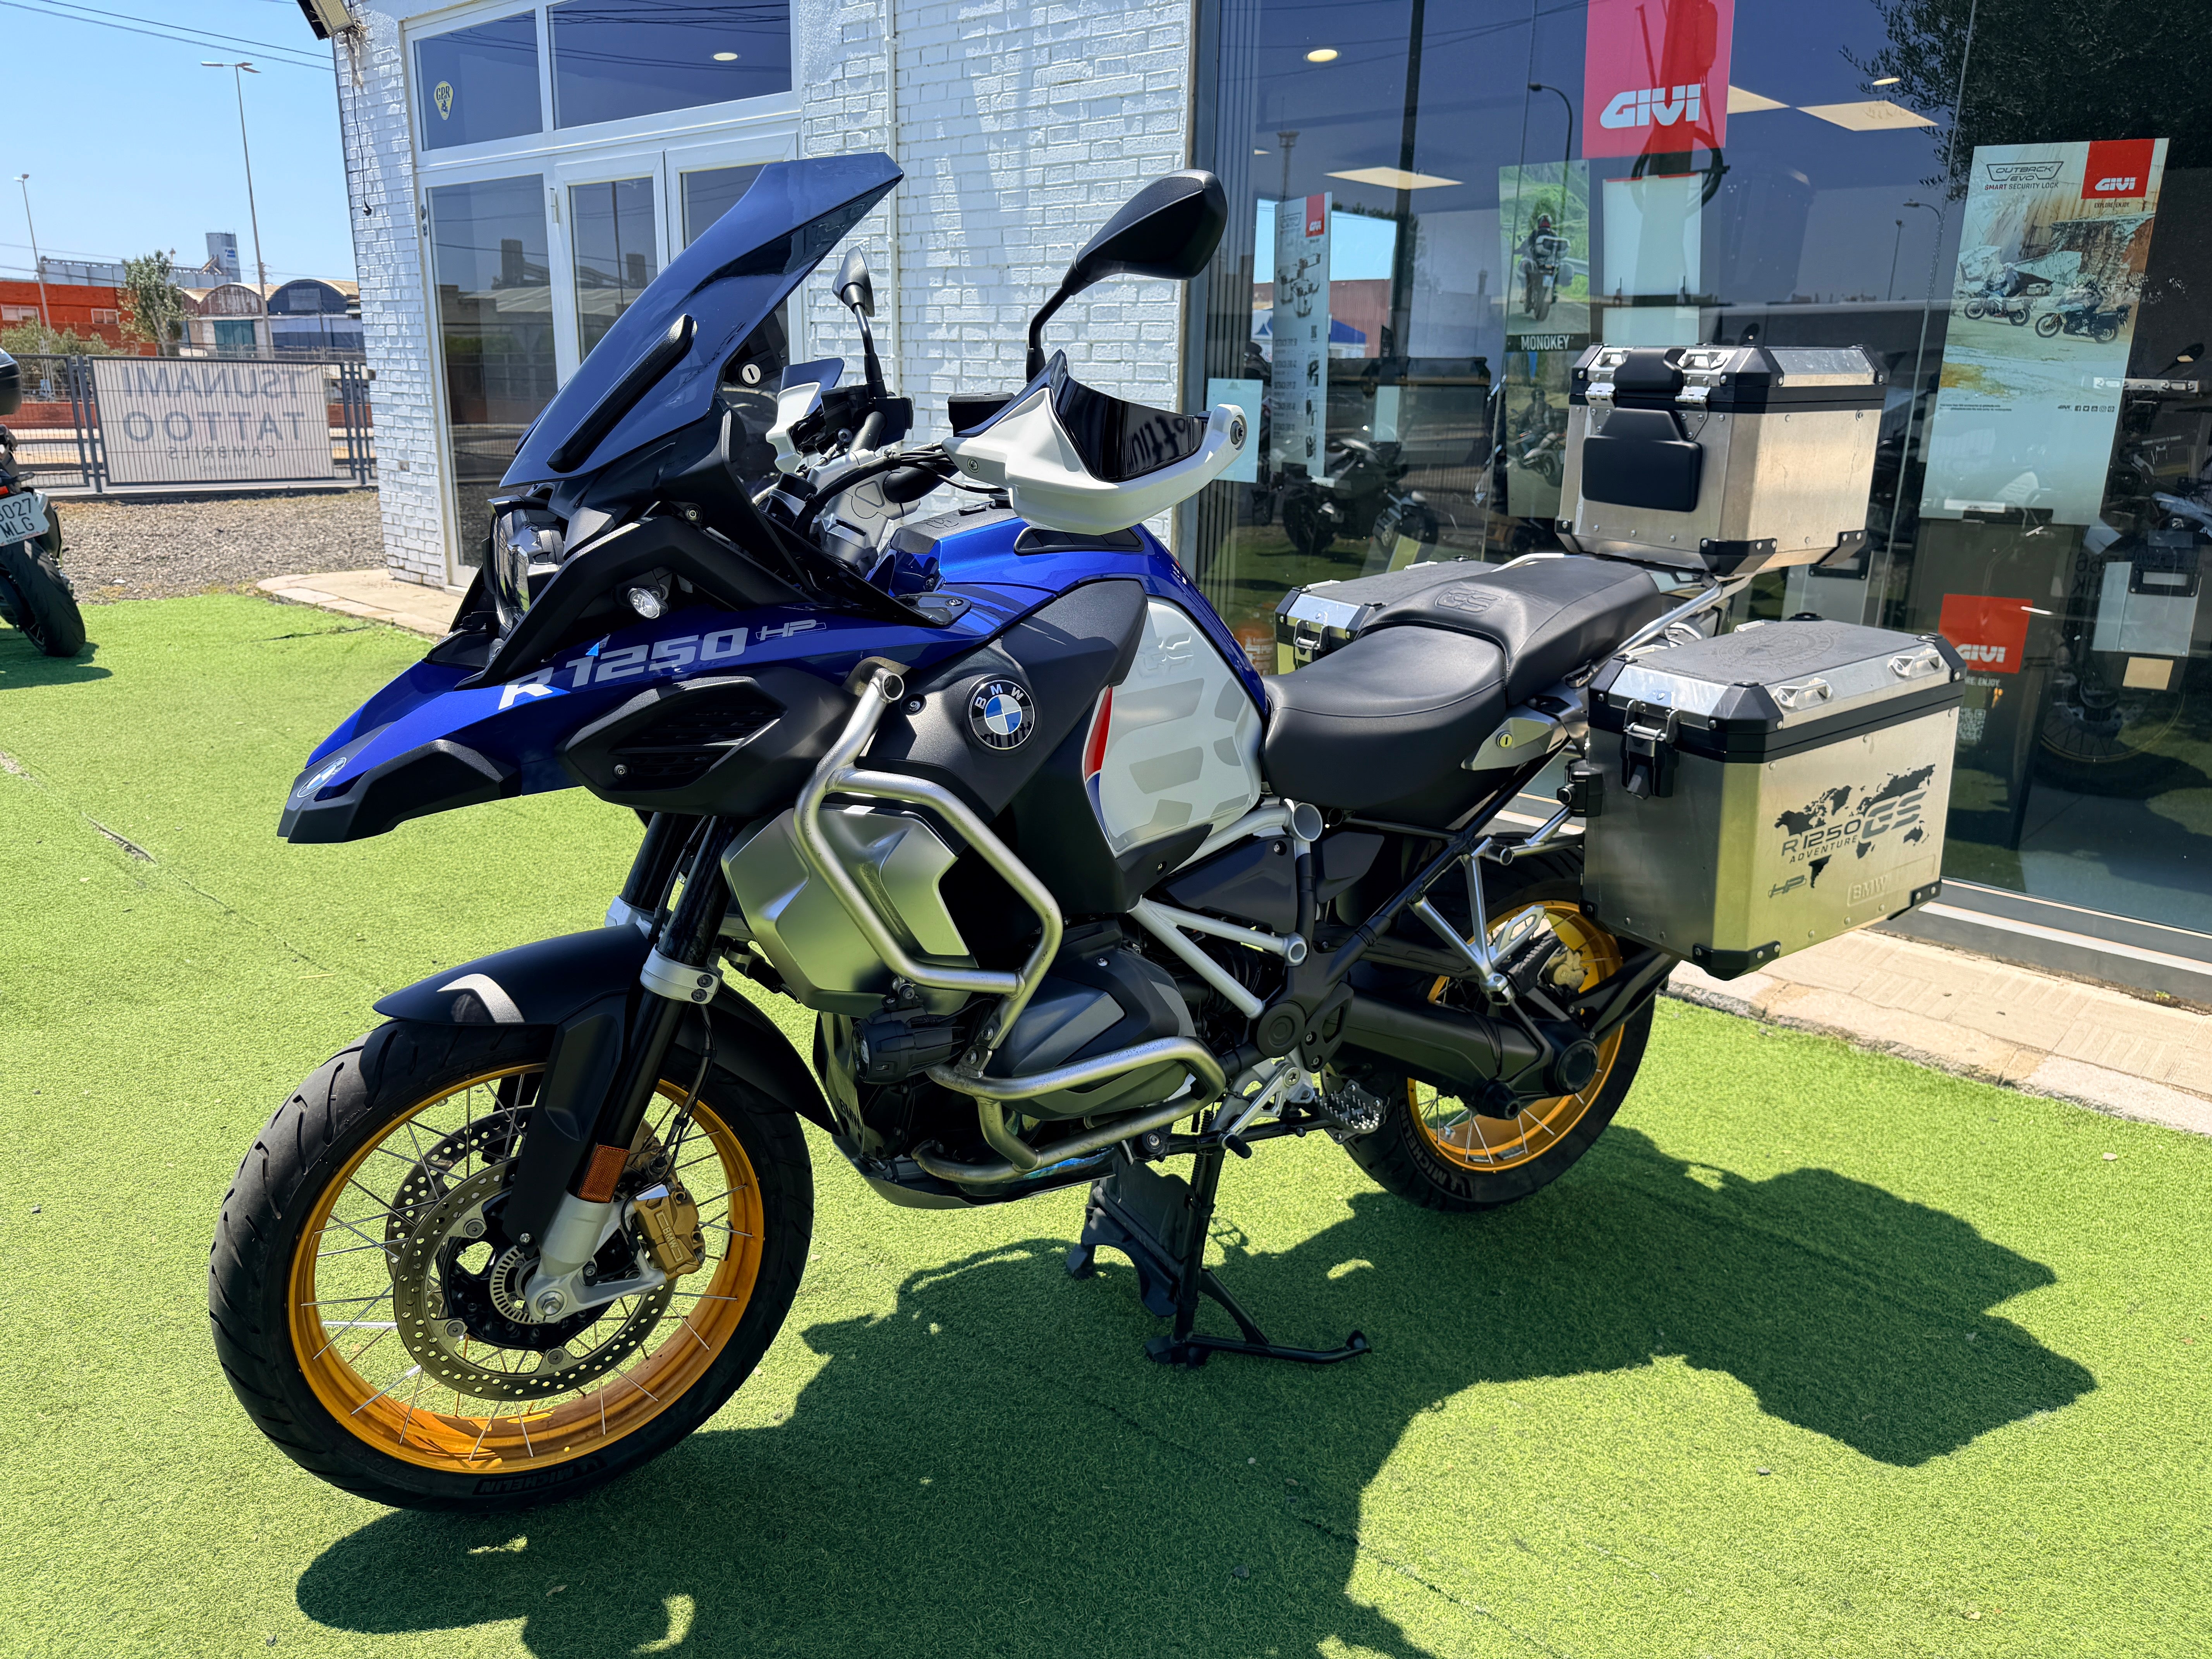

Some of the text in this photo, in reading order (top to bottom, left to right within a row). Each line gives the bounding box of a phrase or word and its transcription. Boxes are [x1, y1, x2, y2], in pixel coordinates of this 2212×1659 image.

[436, 86, 450, 101] GPR
[1600, 84, 1701, 129] GIVI
[2095, 177, 2136, 191] GIVI
[1521, 335, 1570, 350] MONOKEY
[0, 517, 34, 538] MLG
[498, 619, 822, 710] R 1250 HP
[1955, 644, 2006, 663] GIVI
[1978, 677, 2001, 687] ENJOY
[974, 684, 1024, 709] BMW
[1781, 790, 1927, 856] R 1250 GS
[1789, 835, 1858, 864] ADVENTURE
[1853, 875, 1888, 900] BMW
[839, 1097, 860, 1130] BMW
[1398, 1104, 1448, 1185] MICHELIN
[663, 1226, 678, 1249] BMW
[479, 1467, 574, 1493] MICHELIN
